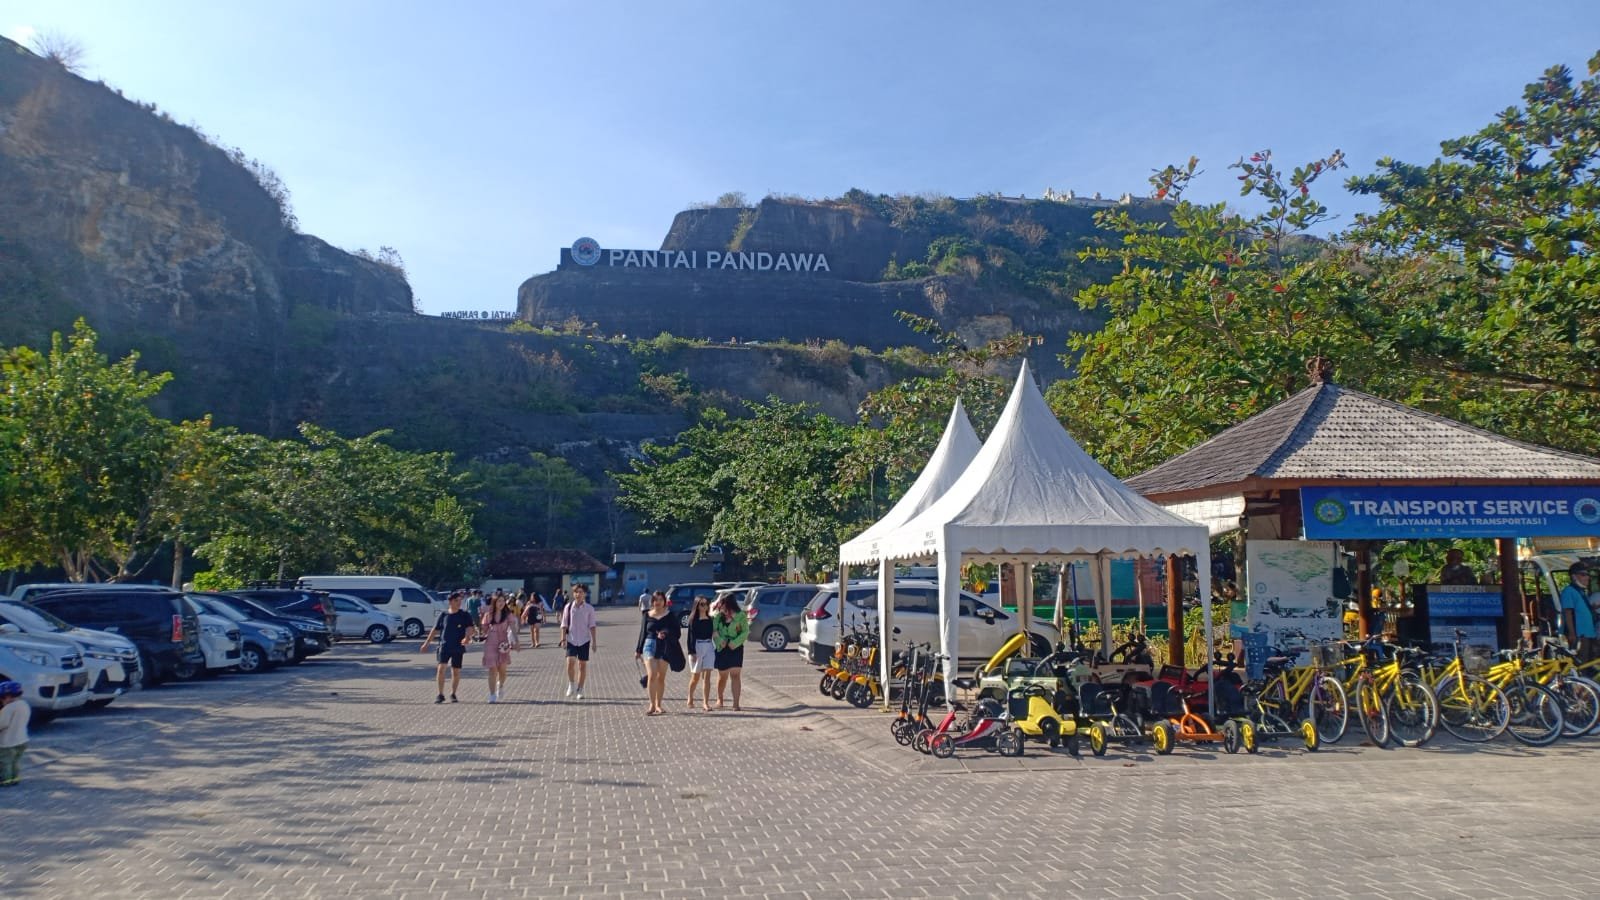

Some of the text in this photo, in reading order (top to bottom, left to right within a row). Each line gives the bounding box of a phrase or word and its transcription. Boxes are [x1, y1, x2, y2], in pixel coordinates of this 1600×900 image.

[609, 250, 697, 269] PANTAI
[706, 250, 831, 271] PANDAWA
[1350, 500, 1477, 515] TRANSPORT
[1483, 500, 1569, 515] SERVICE
[1383, 518, 1441, 526] PELAYANAN
[1444, 518, 1468, 526] JASA
[1470, 518, 1541, 526] TRANSPORTASI
[1440, 585, 1486, 593] RECEPTION
